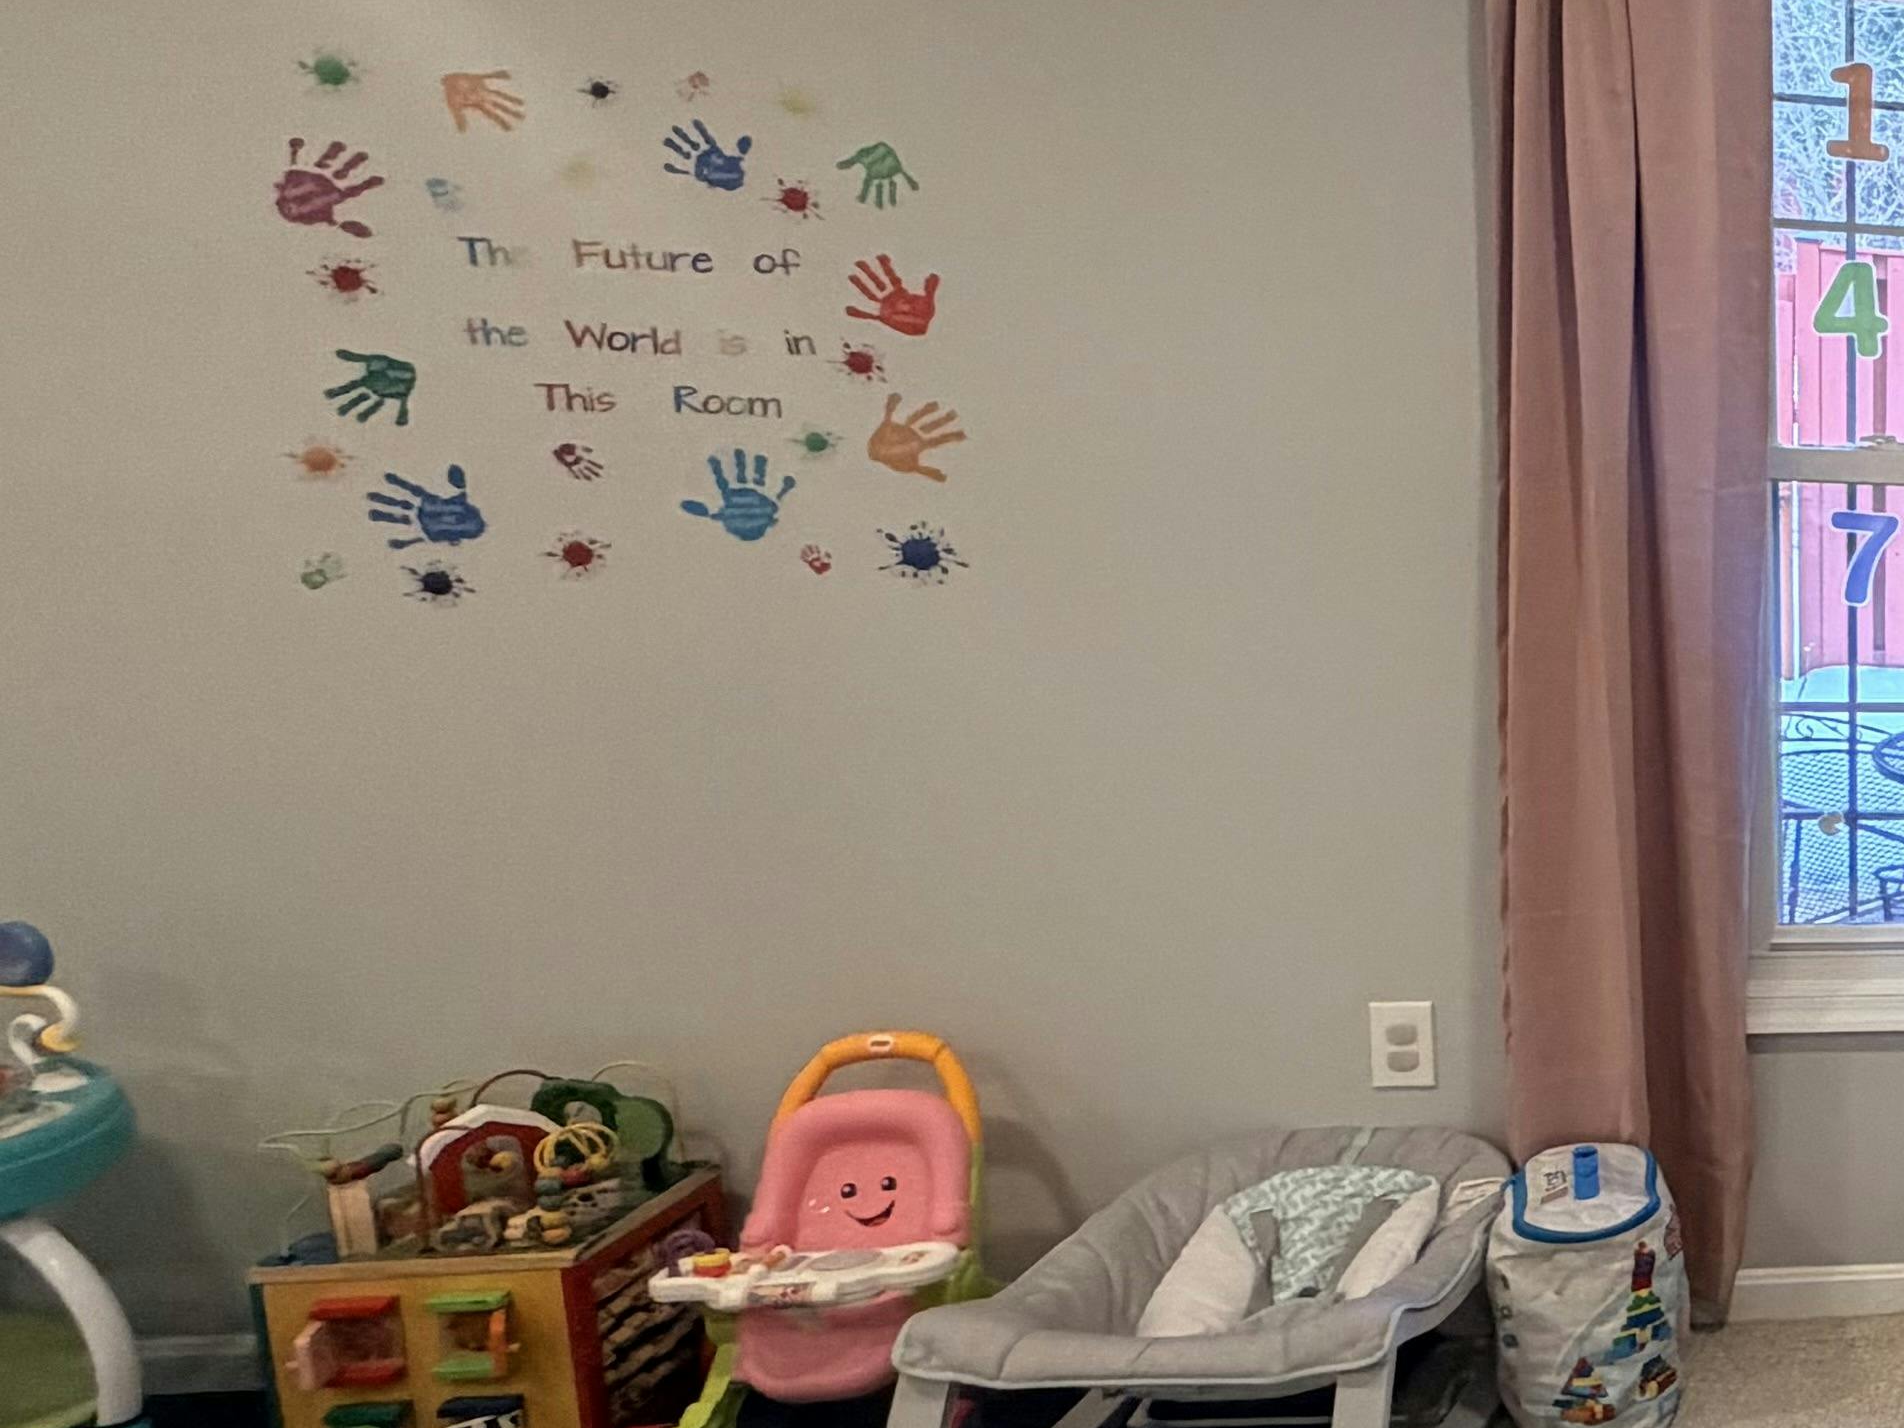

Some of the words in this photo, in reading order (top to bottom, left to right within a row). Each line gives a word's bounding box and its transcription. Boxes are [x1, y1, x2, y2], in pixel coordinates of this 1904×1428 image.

[1827, 62, 1889, 162] 1
[457, 236, 530, 268] Th
[573, 239, 714, 273] Future
[755, 248, 801, 276] of
[464, 318, 529, 347] the
[564, 320, 682, 356] World
[783, 329, 817, 356] in
[1813, 261, 1889, 358] 4
[534, 383, 617, 413] This
[673, 385, 782, 419] Room
[1831, 511, 1900, 607] 7
